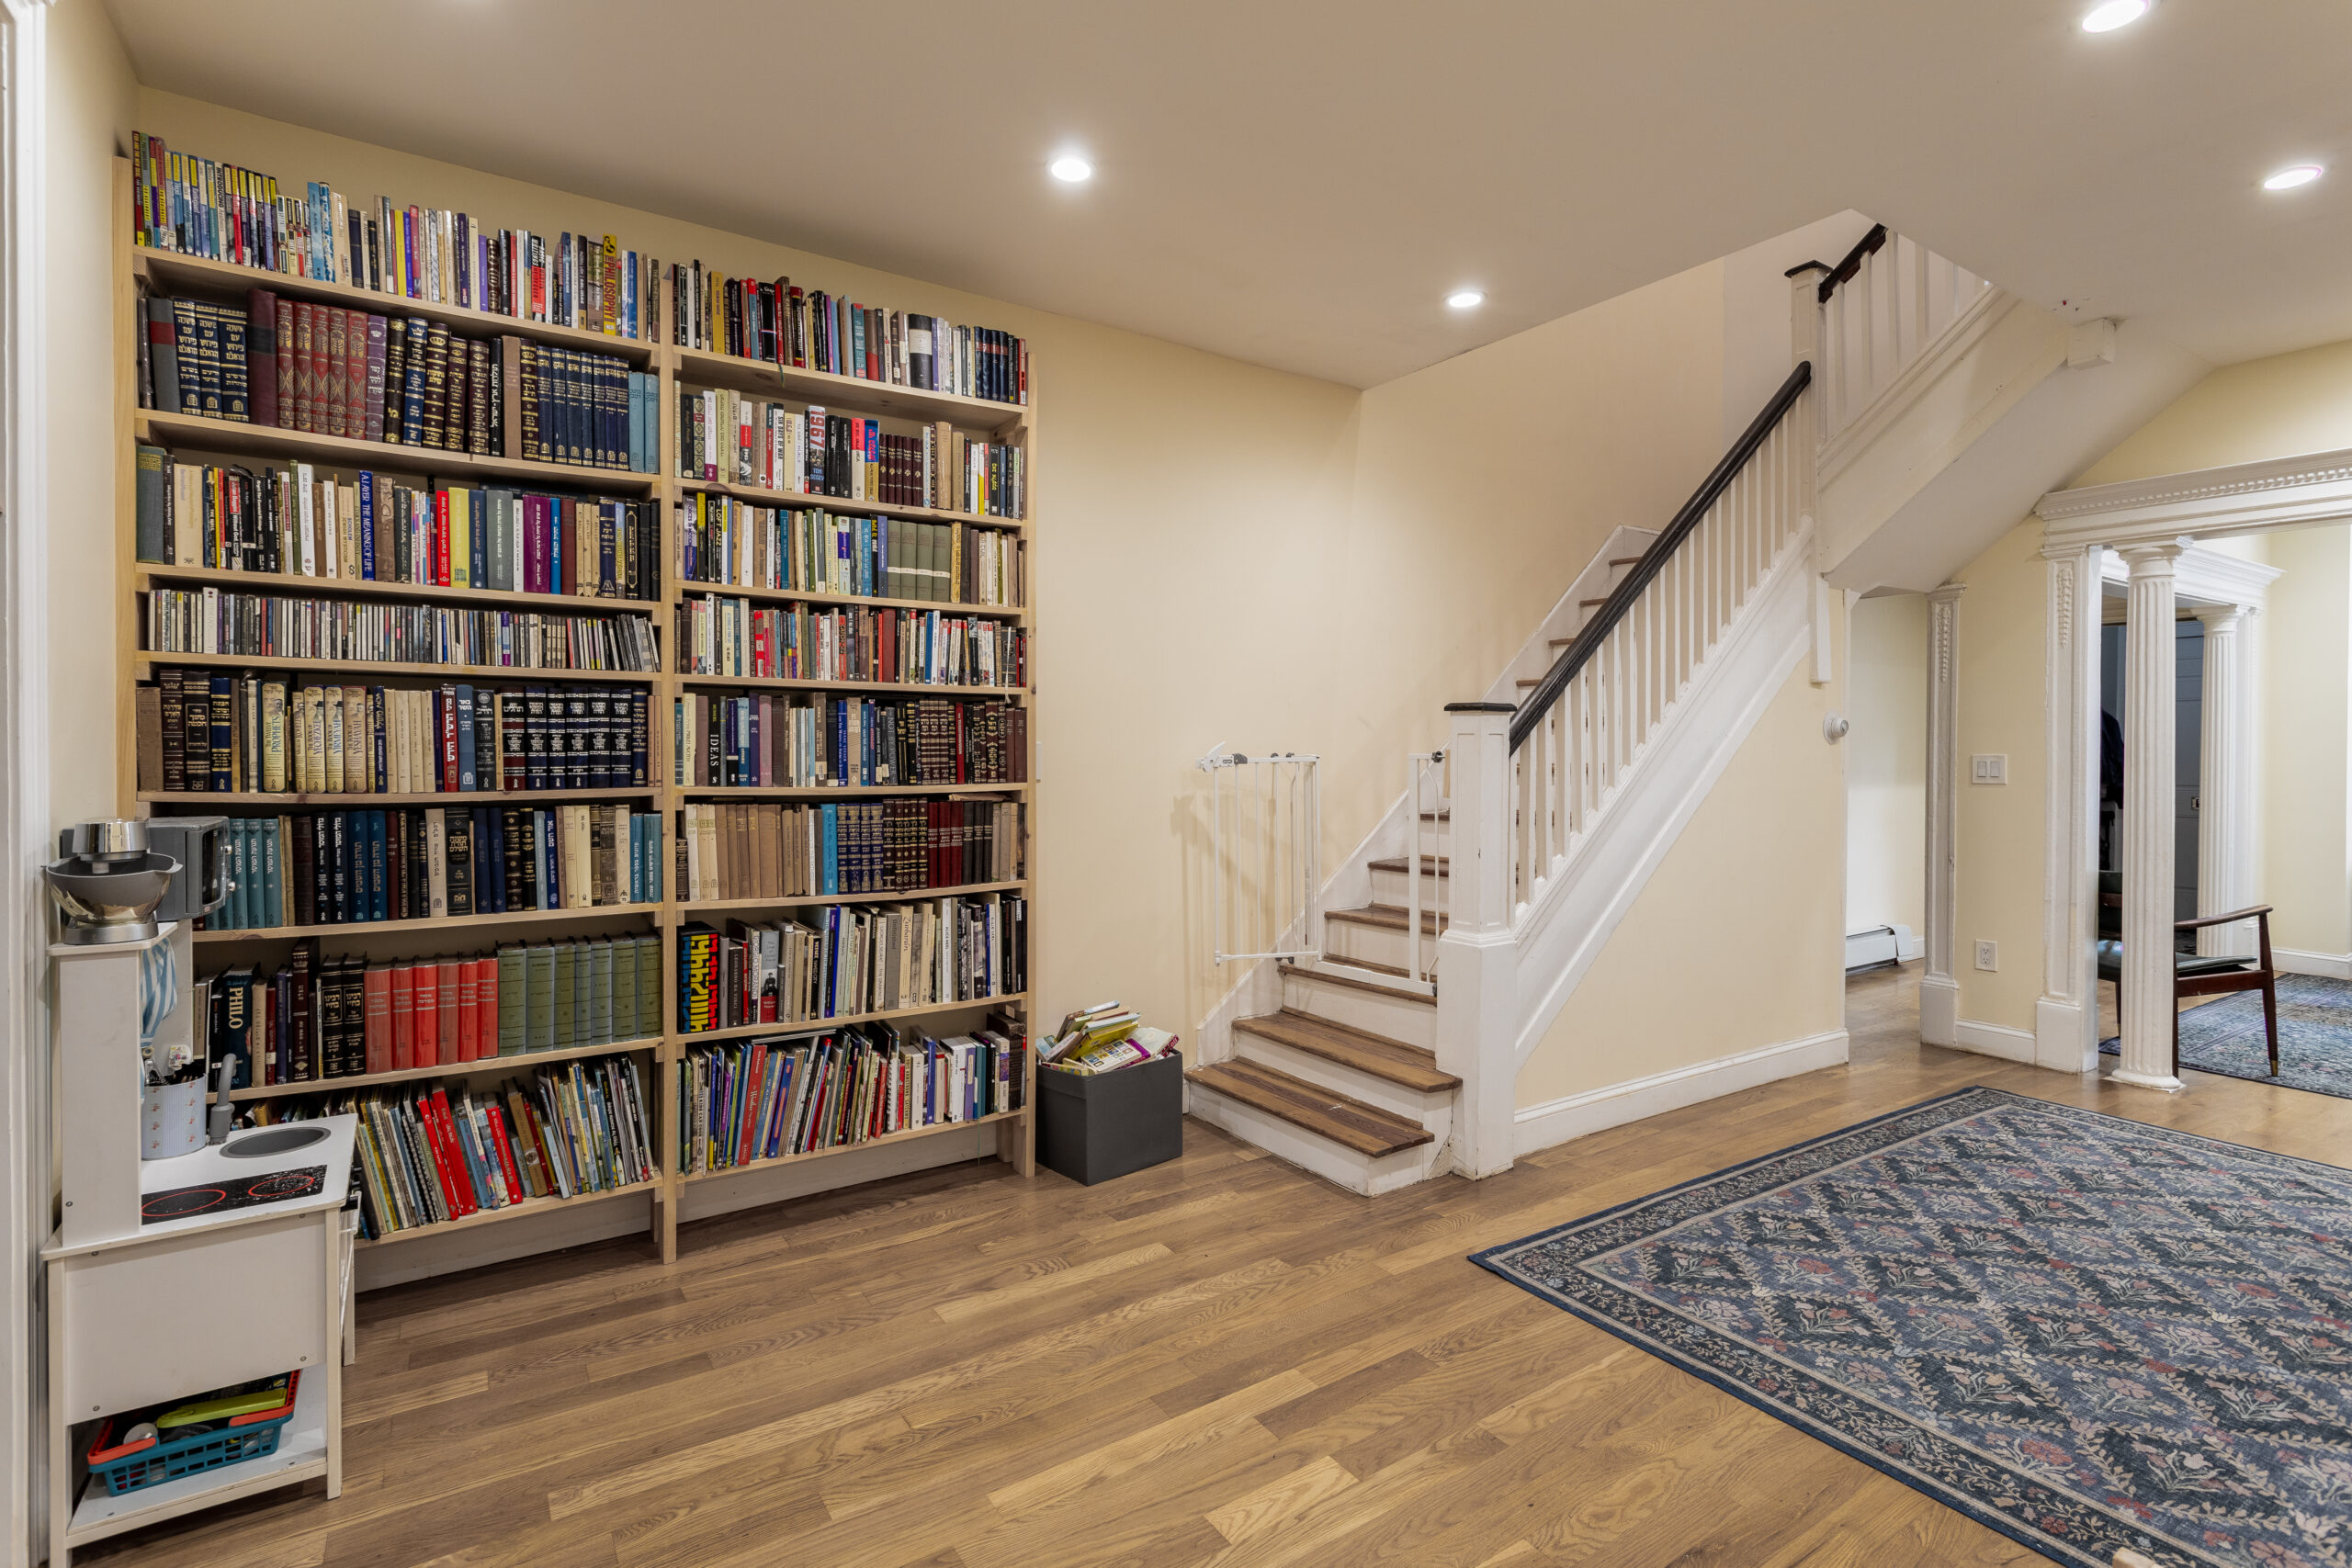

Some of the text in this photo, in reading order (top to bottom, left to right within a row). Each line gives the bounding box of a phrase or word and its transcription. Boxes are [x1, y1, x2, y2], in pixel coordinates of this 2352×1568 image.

[605, 262, 616, 318] PHILOSOPHY
[810, 410, 824, 448] 1967
[362, 484, 370, 502] AYER
[363, 518, 371, 547] MEANING
[364, 548, 372, 558] OF
[364, 558, 372, 571] LIFE
[271, 716, 282, 752] PROPHETS
[312, 720, 322, 755] YECHEZKEL
[333, 719, 342, 754] YIRMEYAH
[353, 720, 363, 755] YESHAYAH
[888, 737, 895, 745] BY
[447, 741, 456, 761] הירש
[710, 734, 719, 766] IDEAS
[888, 748, 897, 775] POWER
[372, 840, 380, 857] תורה
[354, 841, 365, 893] תורה מן השמים
[373, 868, 381, 892] השמים
[229, 987, 243, 1030] PHILO
[346, 992, 361, 1000] רבינו
